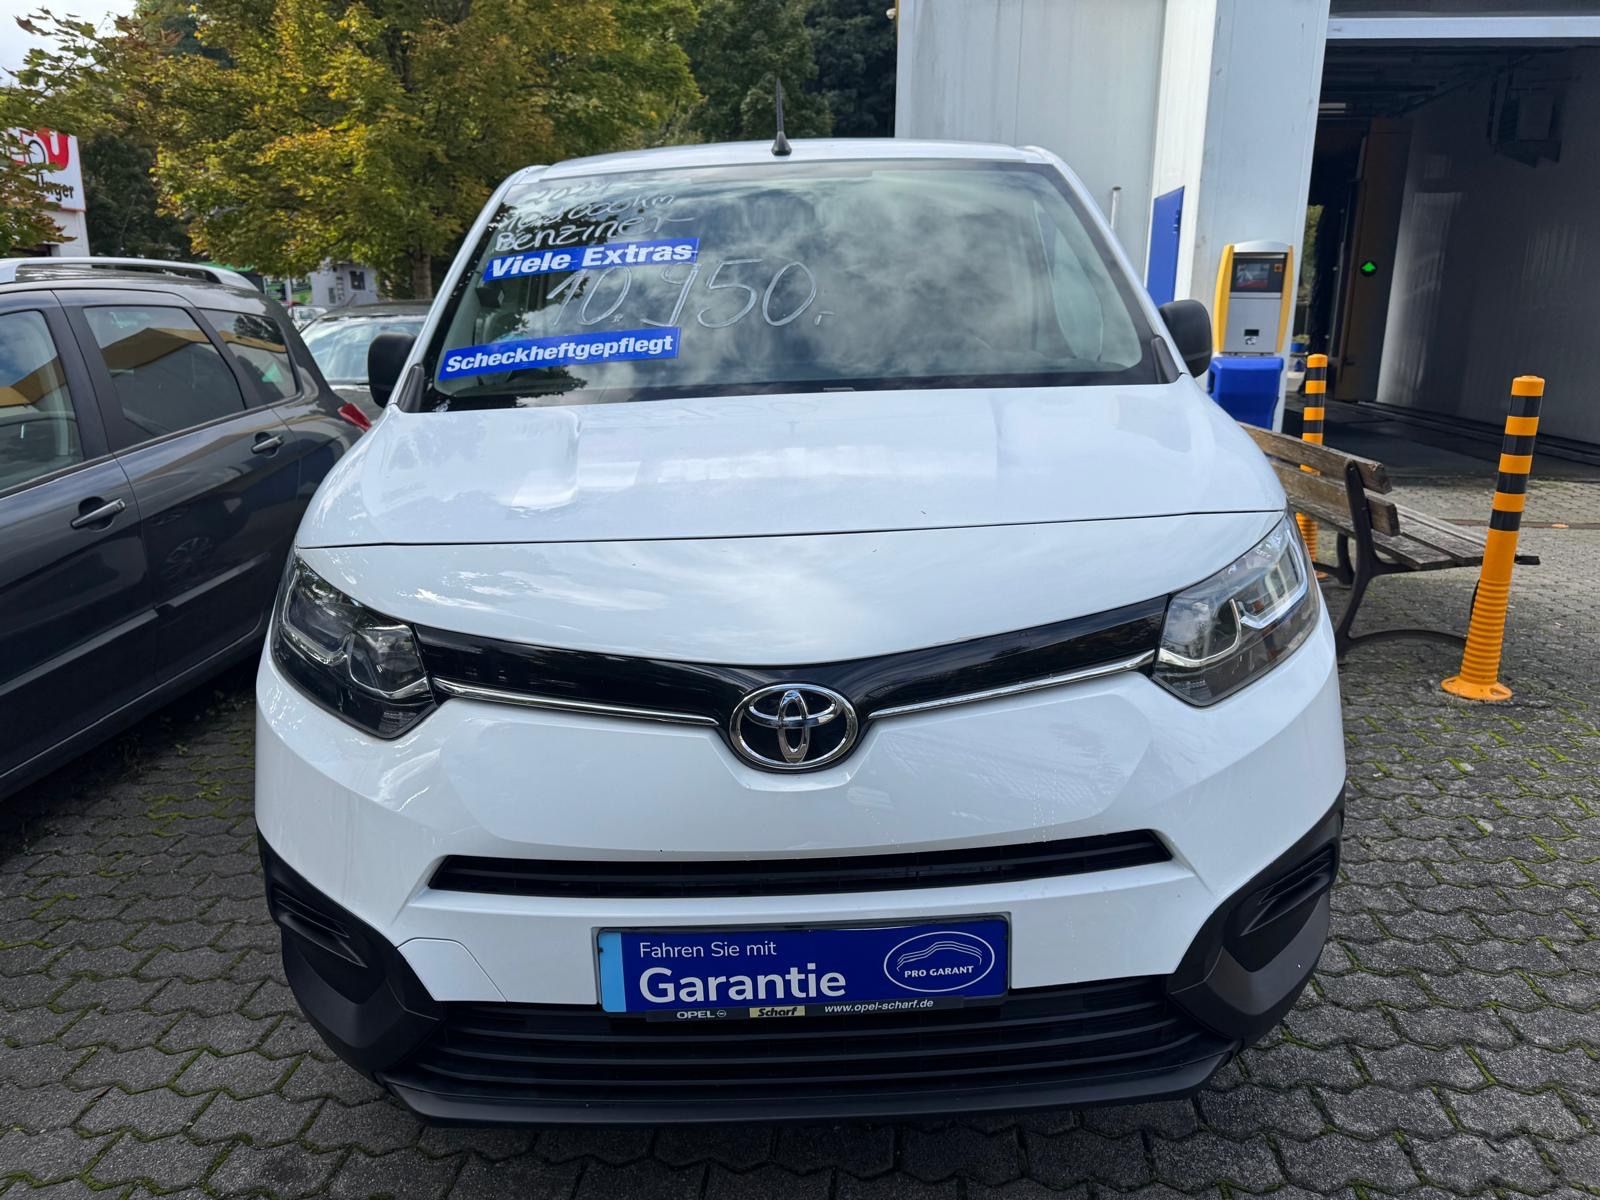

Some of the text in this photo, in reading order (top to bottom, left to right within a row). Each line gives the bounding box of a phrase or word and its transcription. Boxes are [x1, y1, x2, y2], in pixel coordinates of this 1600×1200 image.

[494, 215, 696, 252] Benziner
[491, 243, 694, 278] Viele Extras
[445, 335, 674, 373] Scheckheftgepflegt
[638, 940, 777, 959] Fahren Sie mit
[638, 962, 847, 1004] Garantie
[904, 965, 974, 979] PRO GARANT
[676, 999, 934, 1019] OPEL Scharf www.opel-scharf.de
